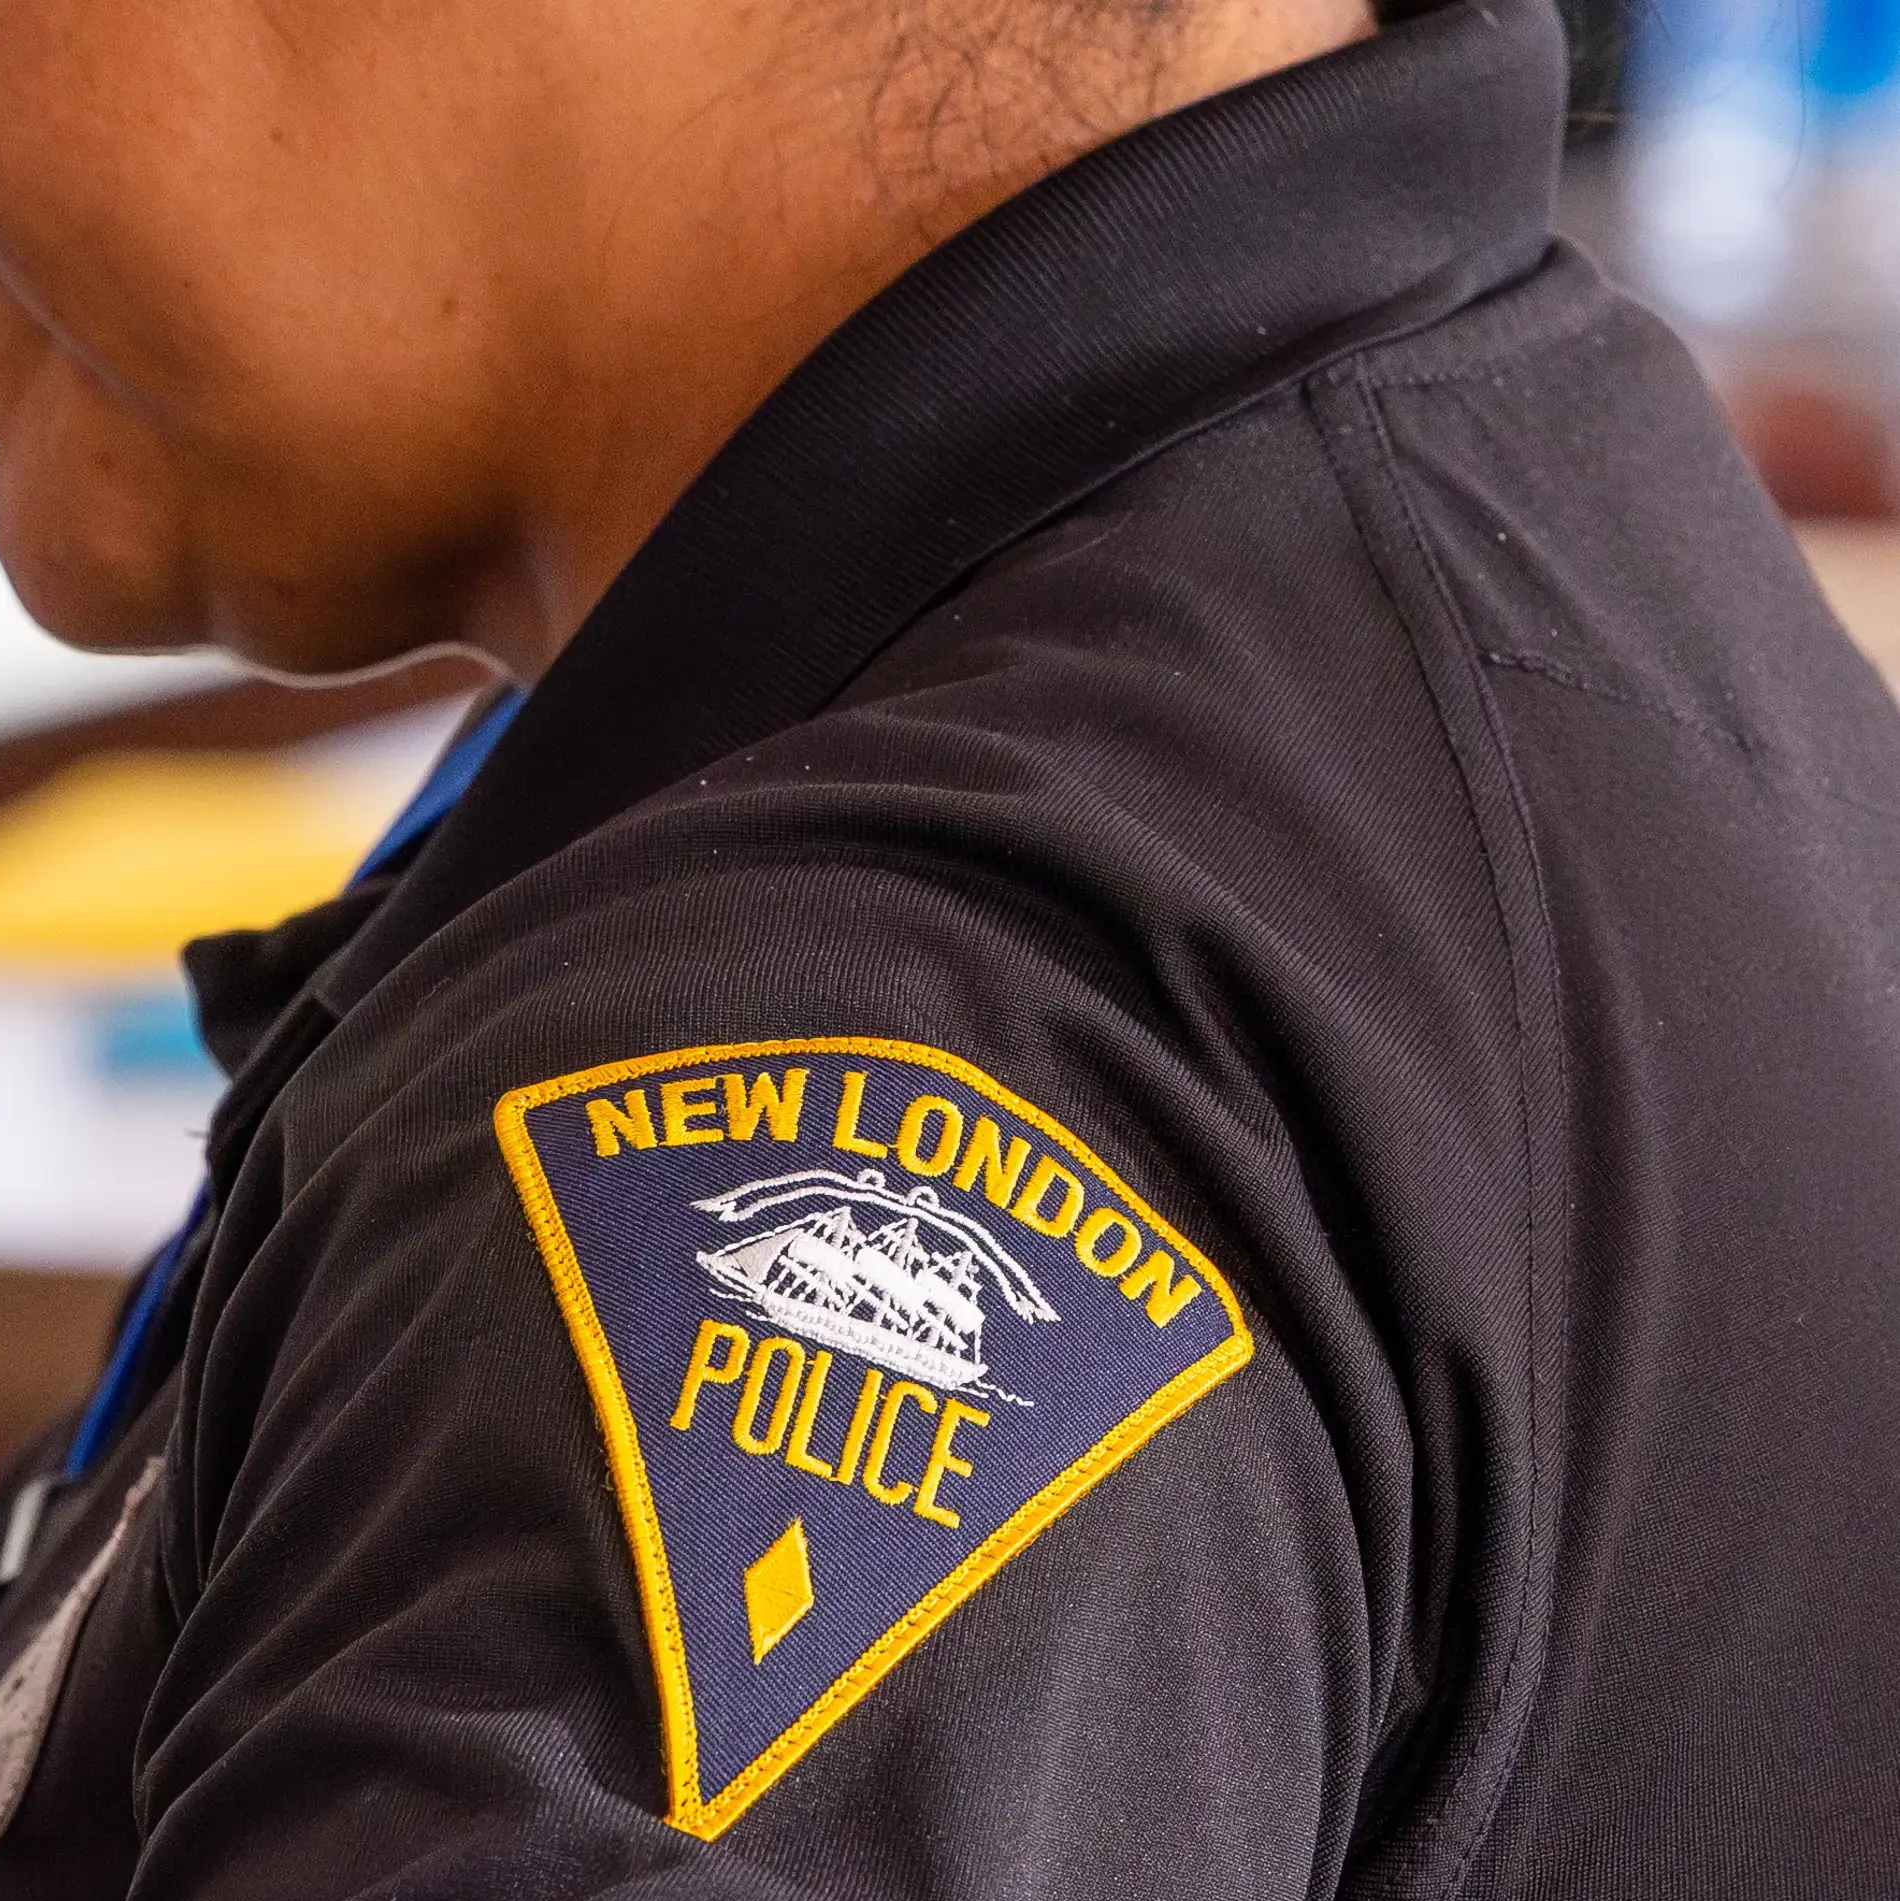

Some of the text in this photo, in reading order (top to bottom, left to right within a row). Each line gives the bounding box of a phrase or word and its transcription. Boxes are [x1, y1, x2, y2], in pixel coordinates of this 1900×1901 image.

[584, 1067, 1202, 1330] NEW LONDON
[669, 1319, 991, 1529] POLICE
